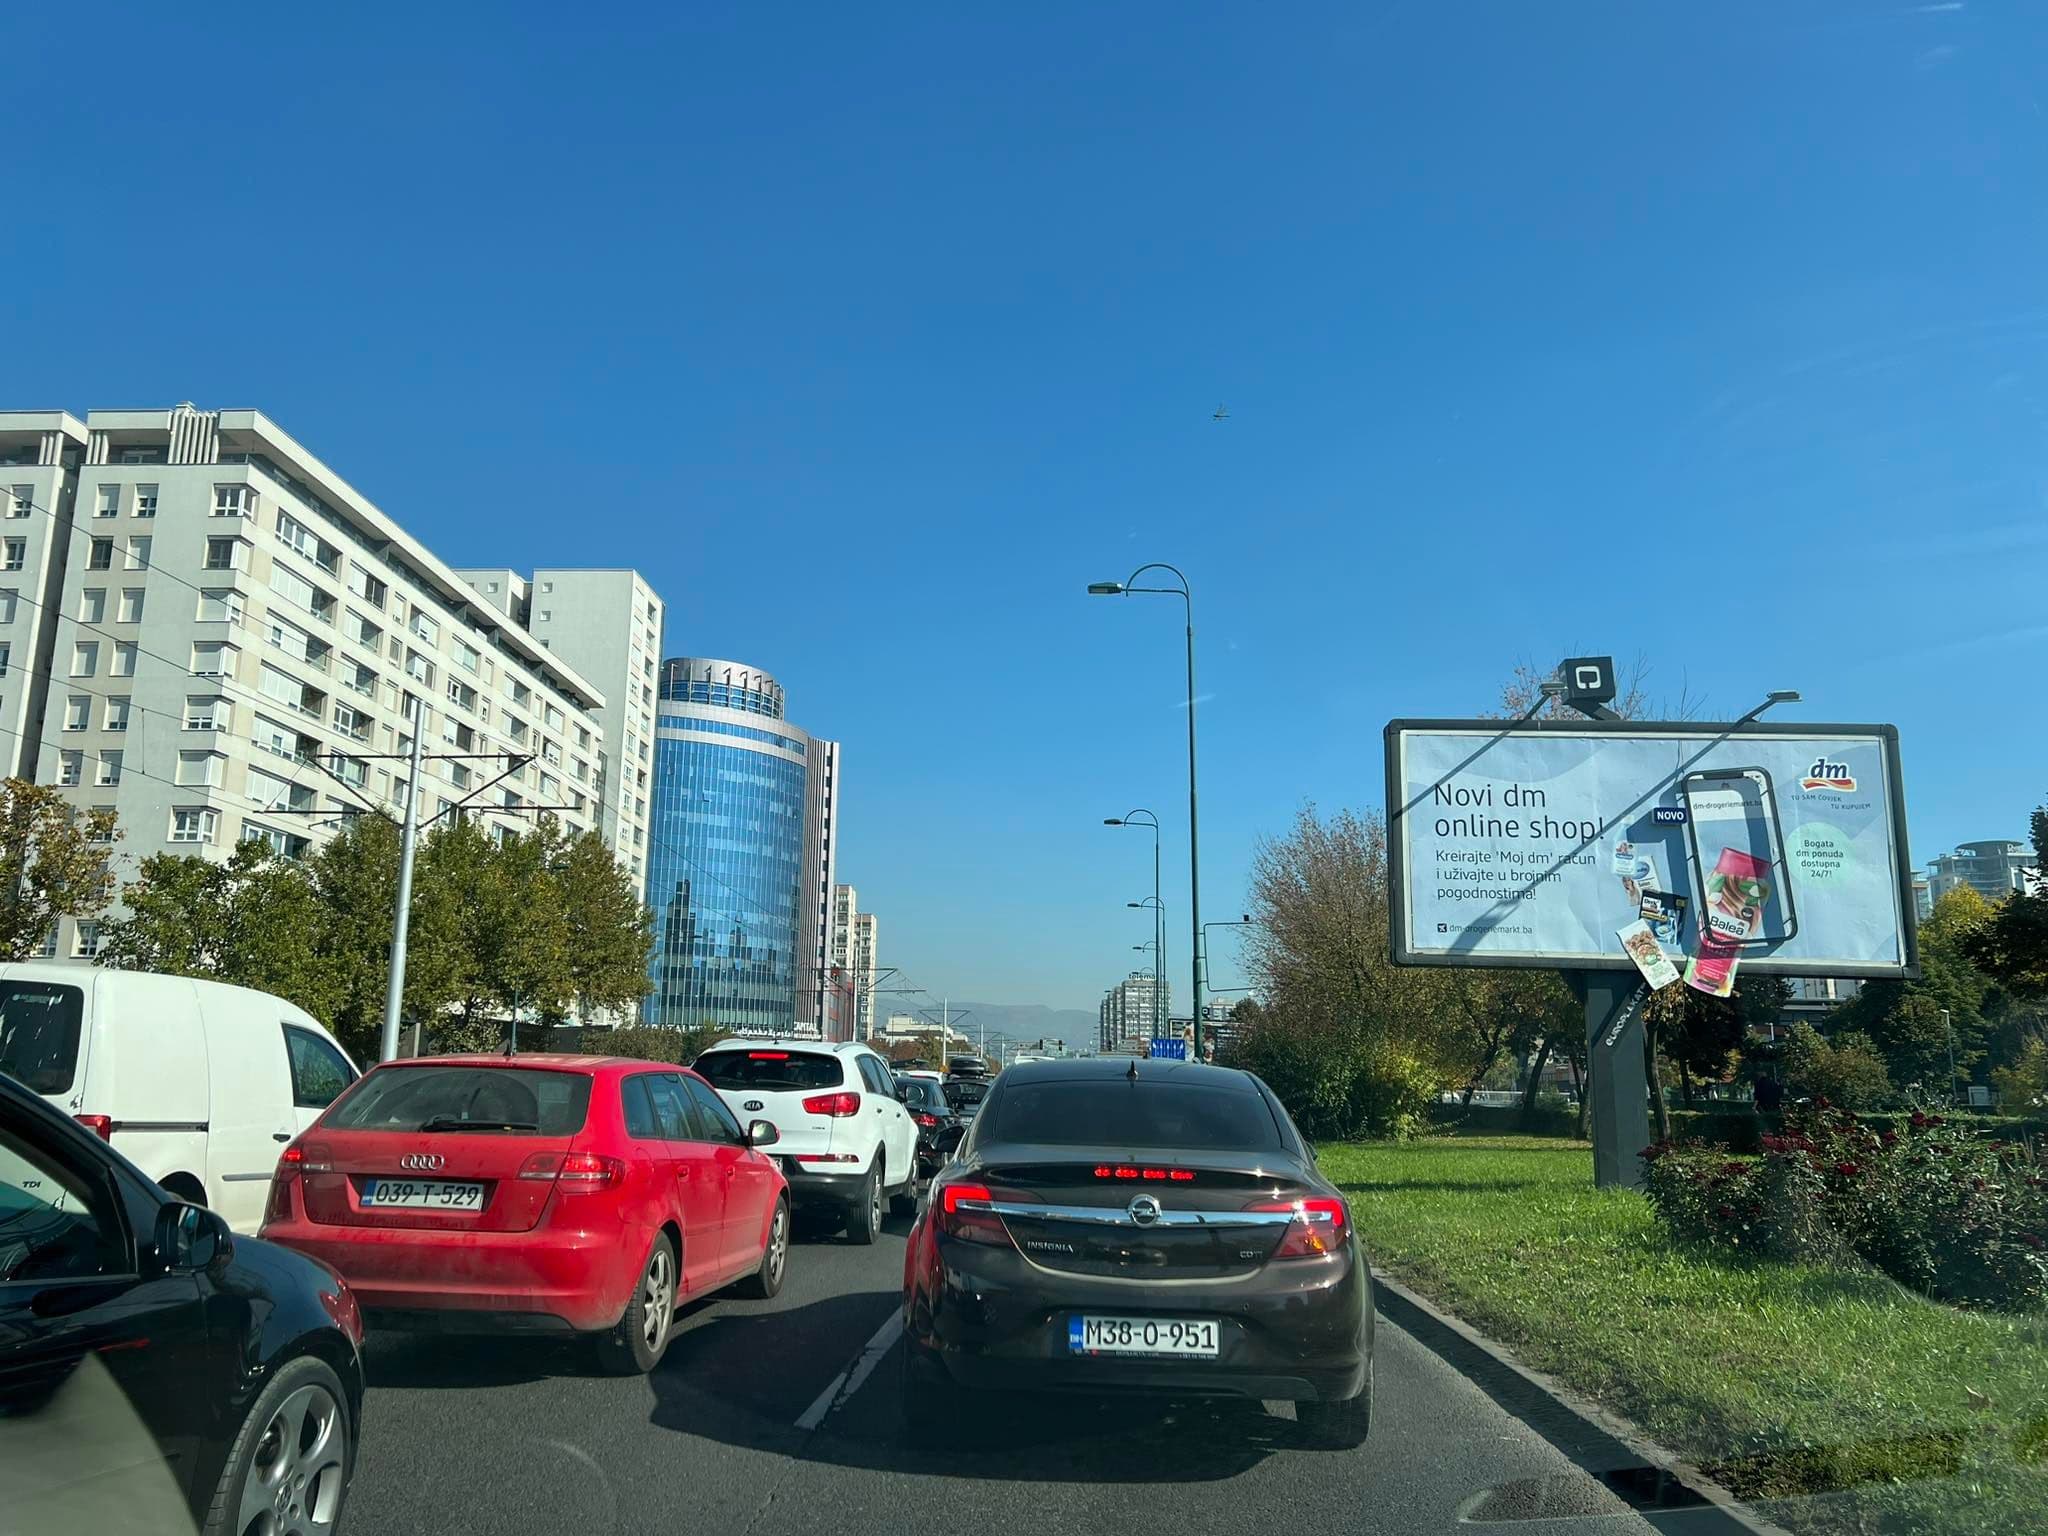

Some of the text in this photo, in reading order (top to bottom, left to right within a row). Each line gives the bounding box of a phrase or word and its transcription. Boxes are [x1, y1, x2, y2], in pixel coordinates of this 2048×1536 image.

[1810, 758, 1848, 779] dm
[1434, 783, 1547, 808] Novi dm
[1656, 811, 1685, 821] NOVO
[1434, 813, 1605, 845] online shop!
[1804, 840, 1834, 848] Bogata
[1435, 850, 1492, 866] Kreirajte
[1496, 851, 1525, 866] 'Moj
[1528, 852, 1553, 864] dm'
[1811, 851, 1844, 859] ponuda
[1800, 860, 1841, 869] dostupna
[1436, 870, 1440, 879] i
[1444, 868, 1494, 883] uživajte
[1510, 870, 1562, 883] brojnim
[1811, 870, 1833, 878] 24/7!
[1437, 887, 1537, 901] pogodnostima!
[1449, 924, 1533, 934] dm-drogeriemarkt.ba
[1710, 915, 1745, 936] Balea
[23, 1180, 41, 1188] TDI
[375, 1183, 480, 1207] 039-T-529
